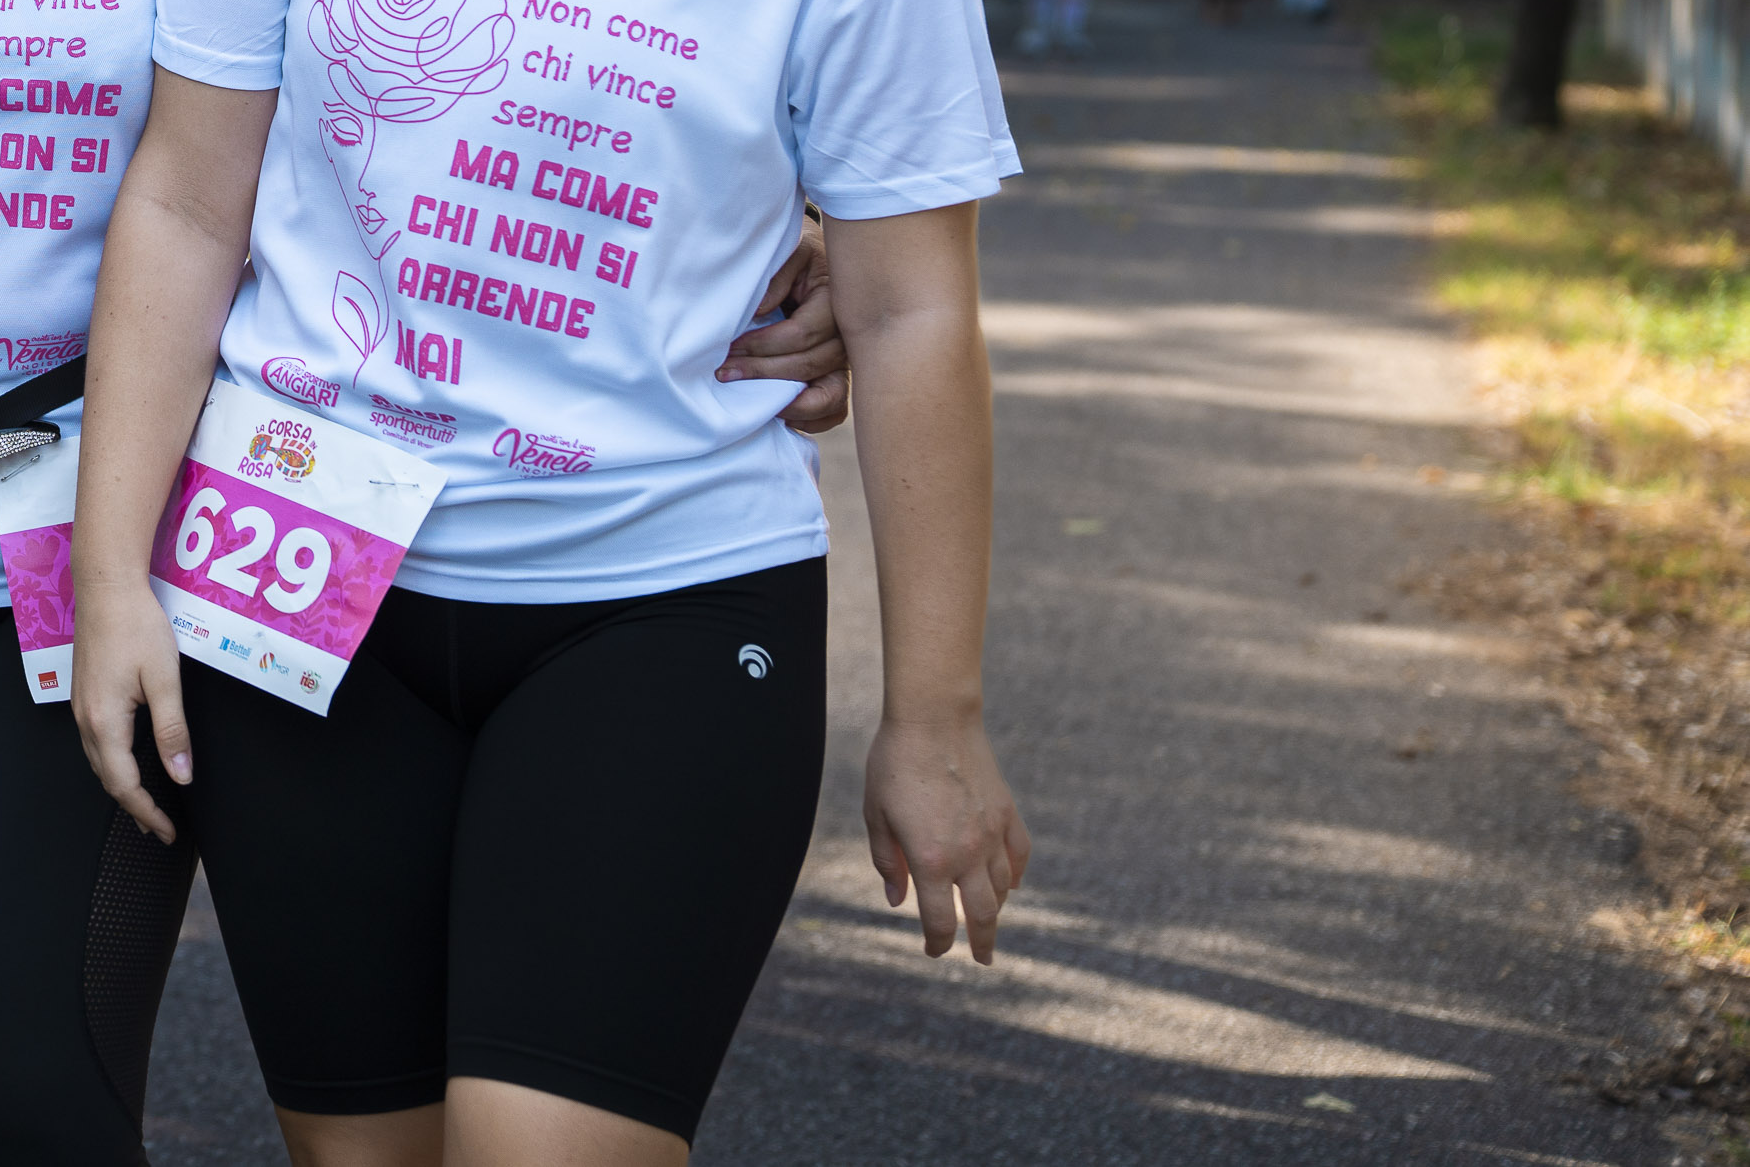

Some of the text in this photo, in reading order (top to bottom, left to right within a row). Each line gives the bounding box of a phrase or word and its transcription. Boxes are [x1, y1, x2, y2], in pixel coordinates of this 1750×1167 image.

[606, 14, 700, 61] come
[0, 79, 122, 117] COME
[522, 44, 677, 109] chi vince
[492, 99, 633, 155] sempre
[71, 138, 110, 173] SI
[449, 139, 659, 229] MA COME
[407, 194, 639, 289] CHI NON SI
[397, 258, 596, 339] ARRENDE
[269, 366, 339, 407] ANGIARI
[280, 360, 341, 391] CENTRO SPORTIVO
[256, 424, 265, 433] LA
[268, 419, 312, 442] CORSA
[369, 411, 457, 444] sportpertutti
[237, 456, 273, 479] ROSA
[493, 428, 593, 472] Veneta
[175, 487, 332, 614] 629
